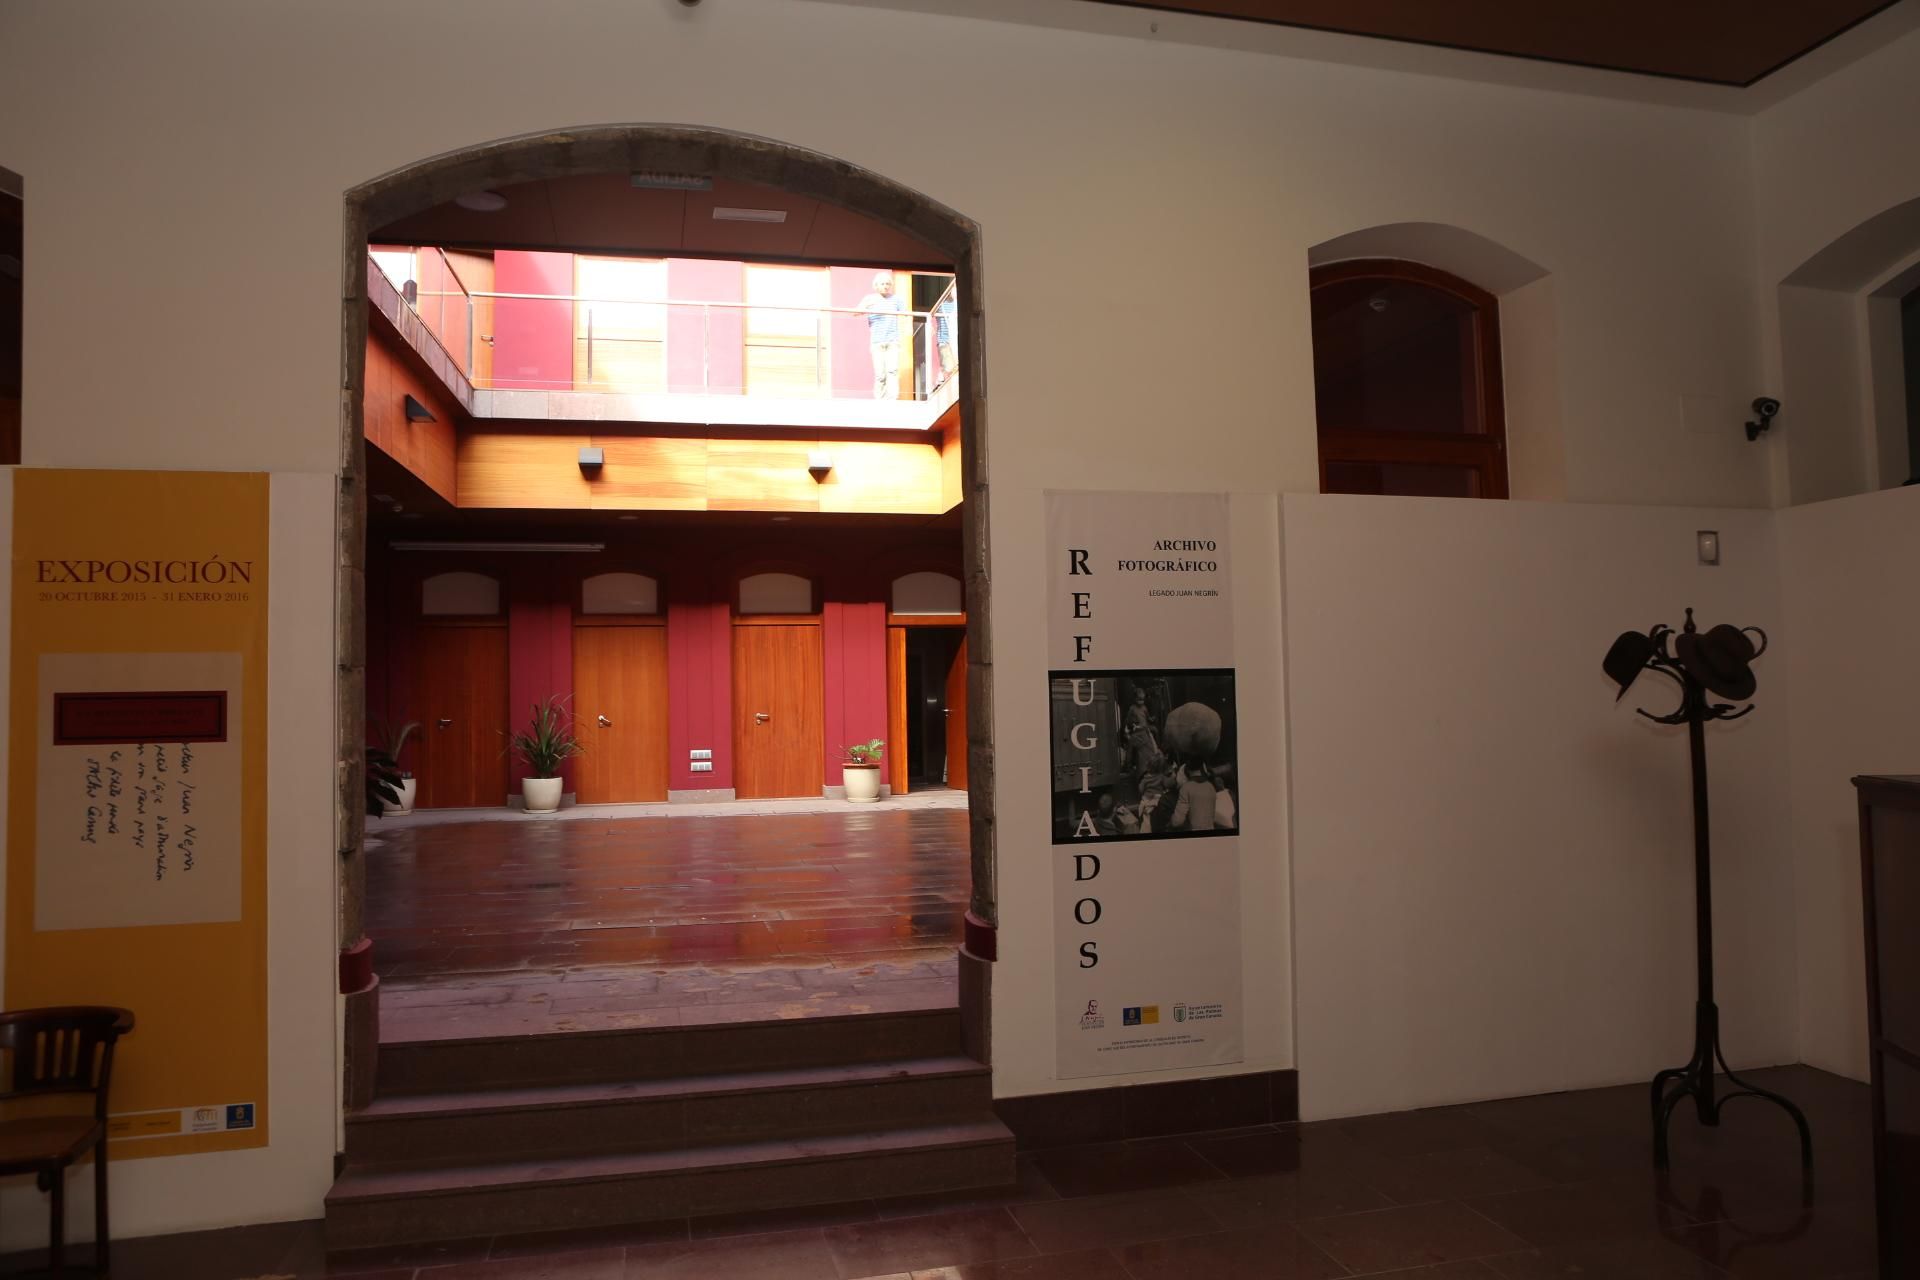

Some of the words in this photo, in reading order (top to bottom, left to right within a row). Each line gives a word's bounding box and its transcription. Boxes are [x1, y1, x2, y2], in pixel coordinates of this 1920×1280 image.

[1153, 540, 1217, 551] ARCHIVO
[35, 554, 253, 584] EXPOSICIÓN
[1117, 557, 1217, 572] FOTOGRÁFICO
[55, 591, 119, 601] OCTUBRE
[178, 591, 222, 601] ENERO
[1149, 589, 1175, 597] LEGADO
[1176, 589, 1193, 597] JUAN
[1067, 548, 1102, 969] REFUGIADOS
